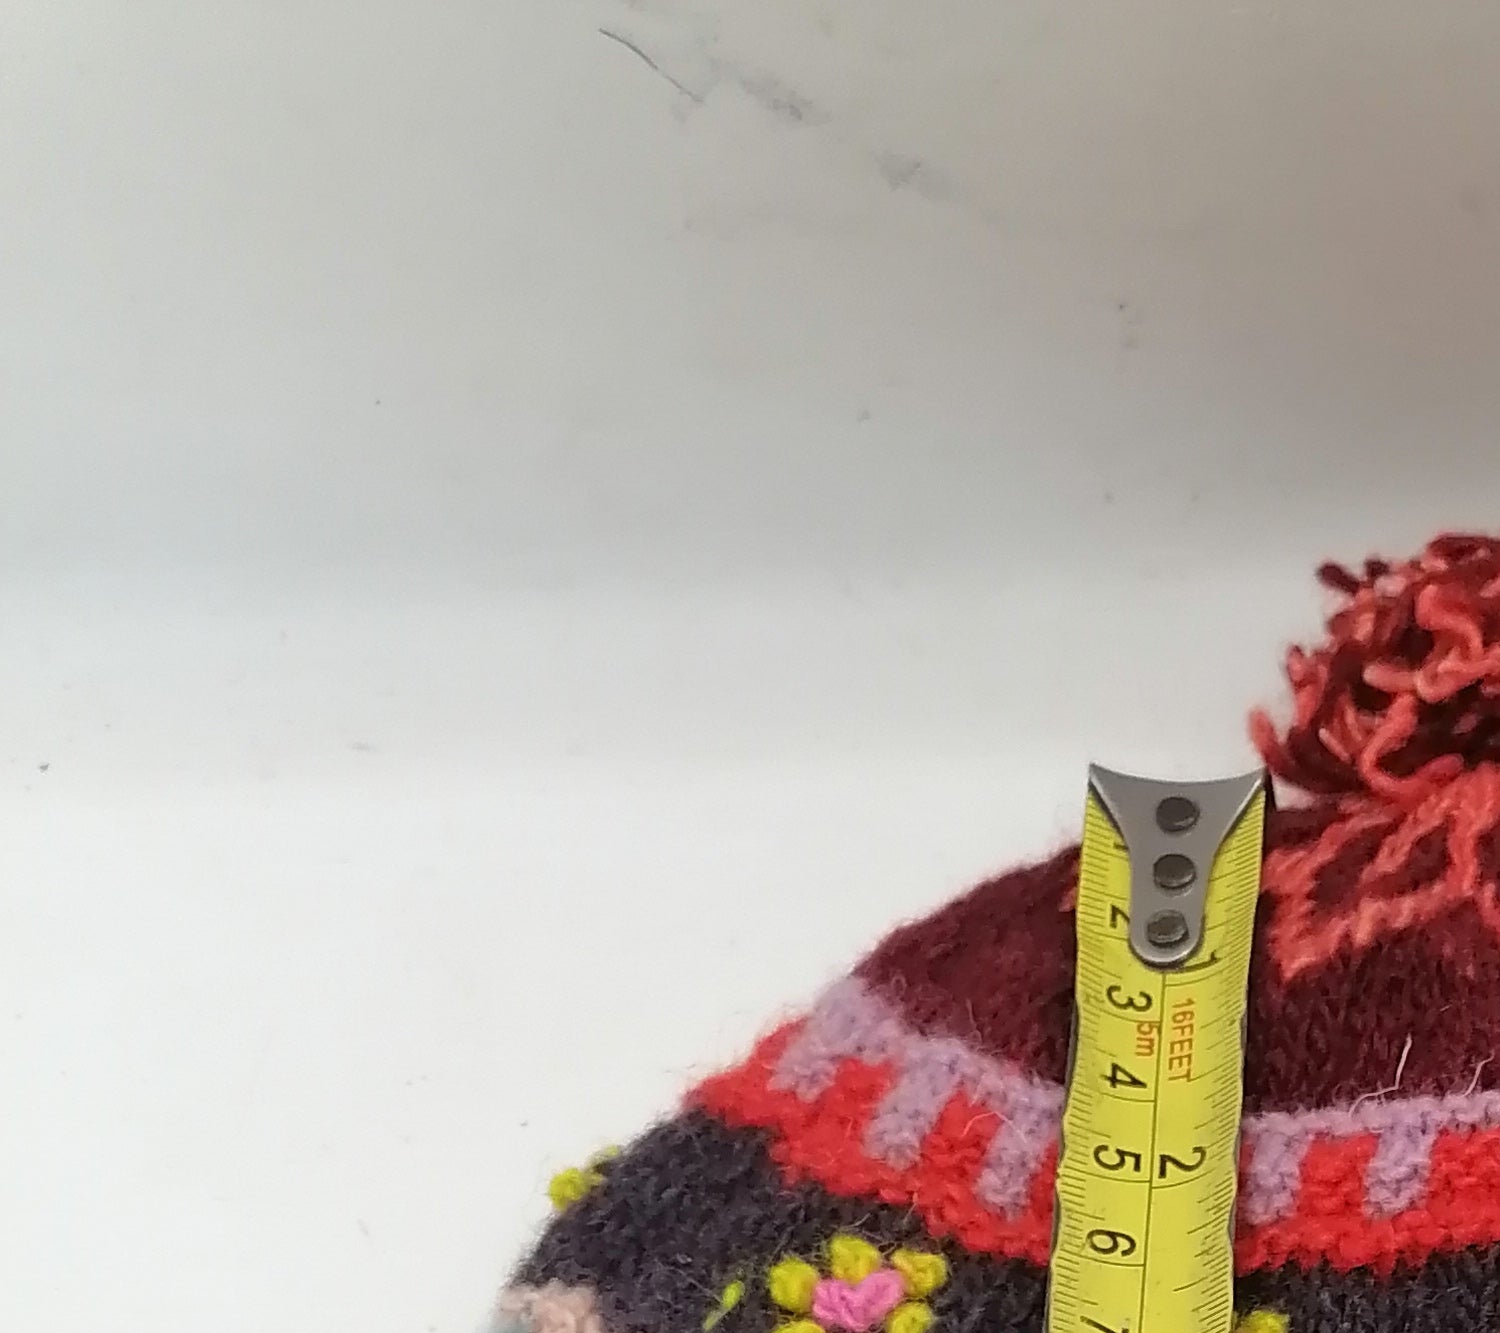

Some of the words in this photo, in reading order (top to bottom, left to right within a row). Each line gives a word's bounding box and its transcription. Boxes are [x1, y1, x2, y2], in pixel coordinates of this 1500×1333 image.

[1107, 985, 1151, 1013] 3
[1135, 1021, 1161, 1057] 5m
[1167, 998, 1195, 1082] 16FEET
[1103, 1062, 1147, 1089] 4
[1093, 1145, 1141, 1172] 5
[1158, 1146, 1207, 1179] 2
[1086, 1229, 1136, 1257] 6
